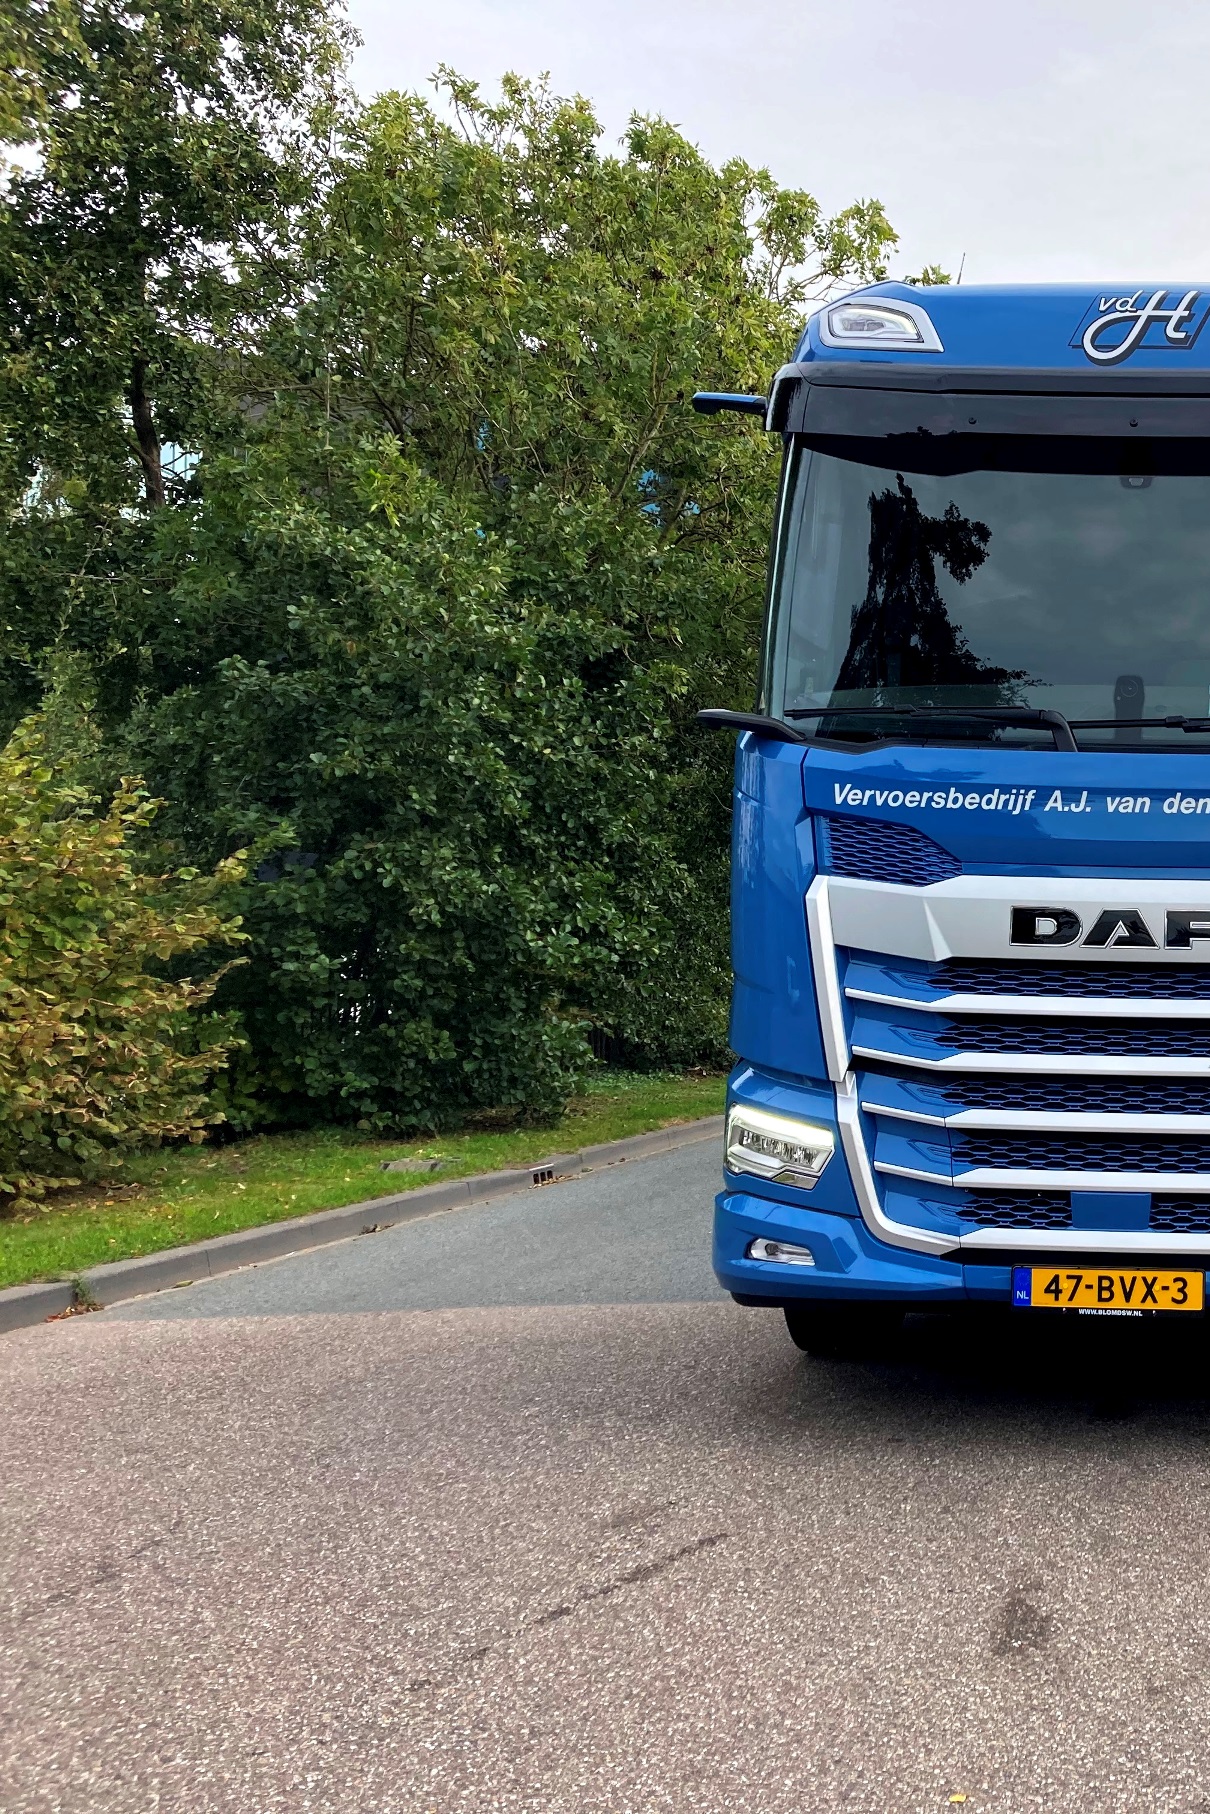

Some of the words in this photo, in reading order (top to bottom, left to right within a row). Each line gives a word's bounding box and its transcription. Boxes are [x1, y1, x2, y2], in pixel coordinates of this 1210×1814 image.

[833, 783, 1036, 815] Vervoersbedrijf
[1044, 790, 1092, 812] A.J.
[1106, 796, 1150, 813] van
[1016, 1290, 1029, 1300] NL
[1044, 1273, 1188, 1305] 47-BVX-3
